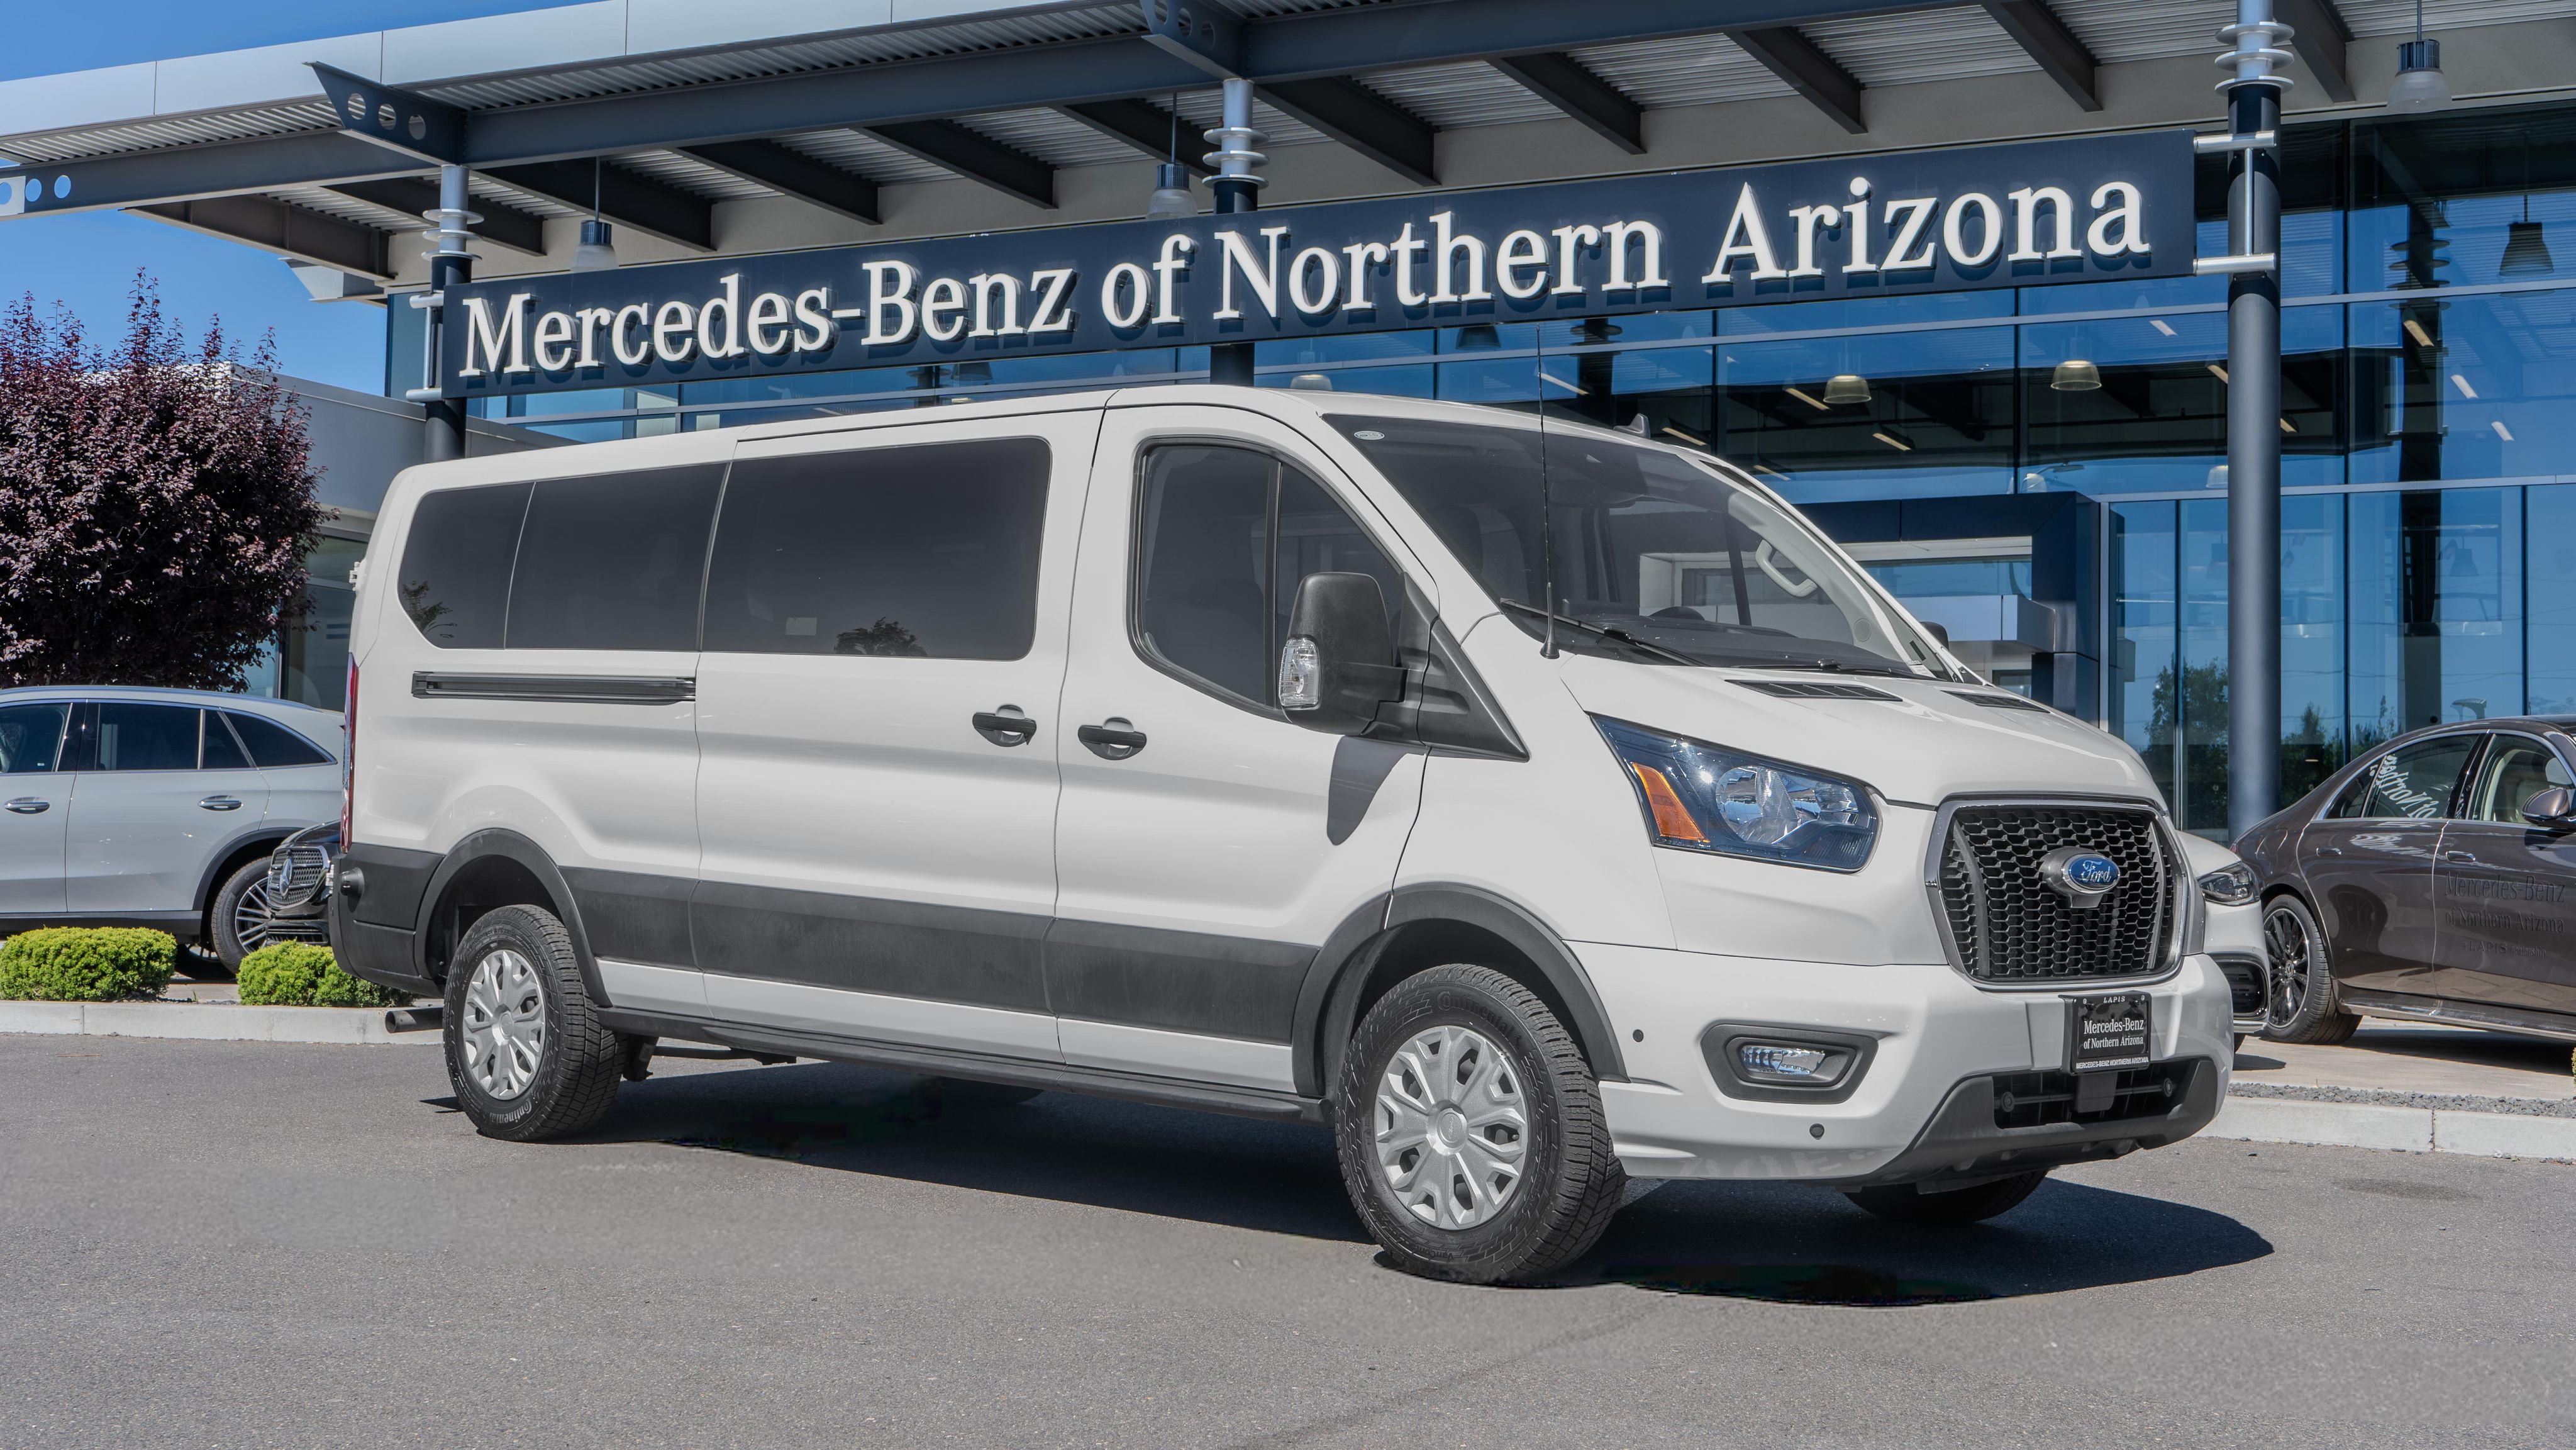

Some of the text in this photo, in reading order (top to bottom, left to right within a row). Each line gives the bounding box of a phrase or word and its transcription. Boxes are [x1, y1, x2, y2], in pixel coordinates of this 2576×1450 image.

[459, 177, 2151, 376] Mercedes-Benz of Northern Arizona
[2077, 860, 2111, 883] Ford
[2445, 871, 2566, 903] Mercedes-Benz
[2445, 907, 2566, 934] of Northern Arizona
[2469, 940, 2507, 954] LAPIS
[2510, 945, 2546, 959] dealership
[1437, 991, 1515, 1040] Continental
[2084, 1017, 2144, 1034] Mercedes-Benz
[2084, 1035, 2143, 1049] of Northern Arizona
[2076, 1060, 2110, 1069] MERCEDES-BENZ
[2110, 1057, 2131, 1066] NORTHERN
[490, 1101, 533, 1124] Continental
